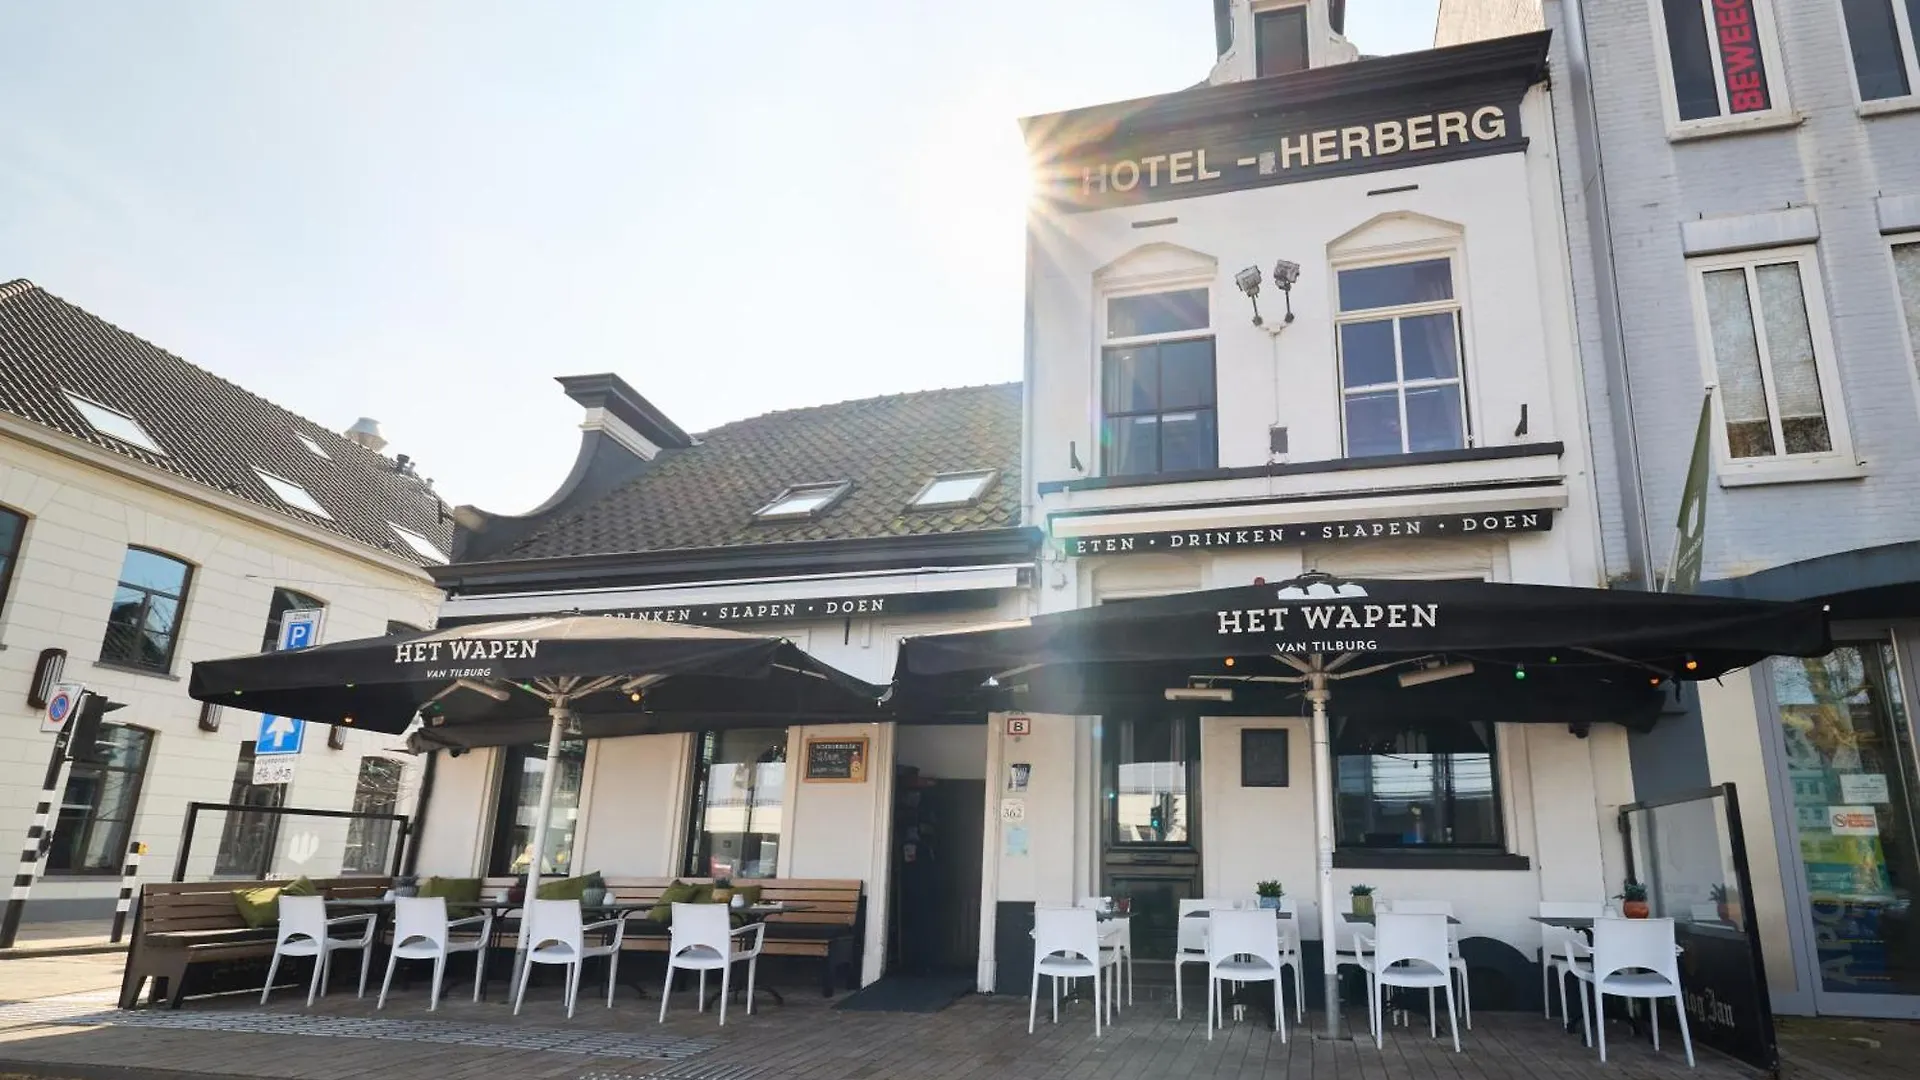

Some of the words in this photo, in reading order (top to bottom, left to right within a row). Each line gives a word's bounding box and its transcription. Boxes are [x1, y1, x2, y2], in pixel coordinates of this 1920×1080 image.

[1081, 148, 1221, 196] HOTEL
[1280, 104, 1507, 170] HERBERG
[1076, 537, 1135, 554] ETEN
[1170, 528, 1285, 548] DRINKEN
[1322, 520, 1422, 539] SLAPEN
[1462, 513, 1539, 532] DOEN
[718, 602, 798, 620] SLAPEN
[825, 598, 886, 615] DOEN
[1217, 607, 1290, 635] HET
[1301, 603, 1439, 630] WAPEN
[394, 642, 443, 664] HET
[449, 638, 540, 661] WAPEN
[1275, 641, 1307, 653] VAN
[1311, 639, 1378, 652] TILBURG
[426, 669, 447, 679] VAN
[450, 667, 492, 678] TILBURG
